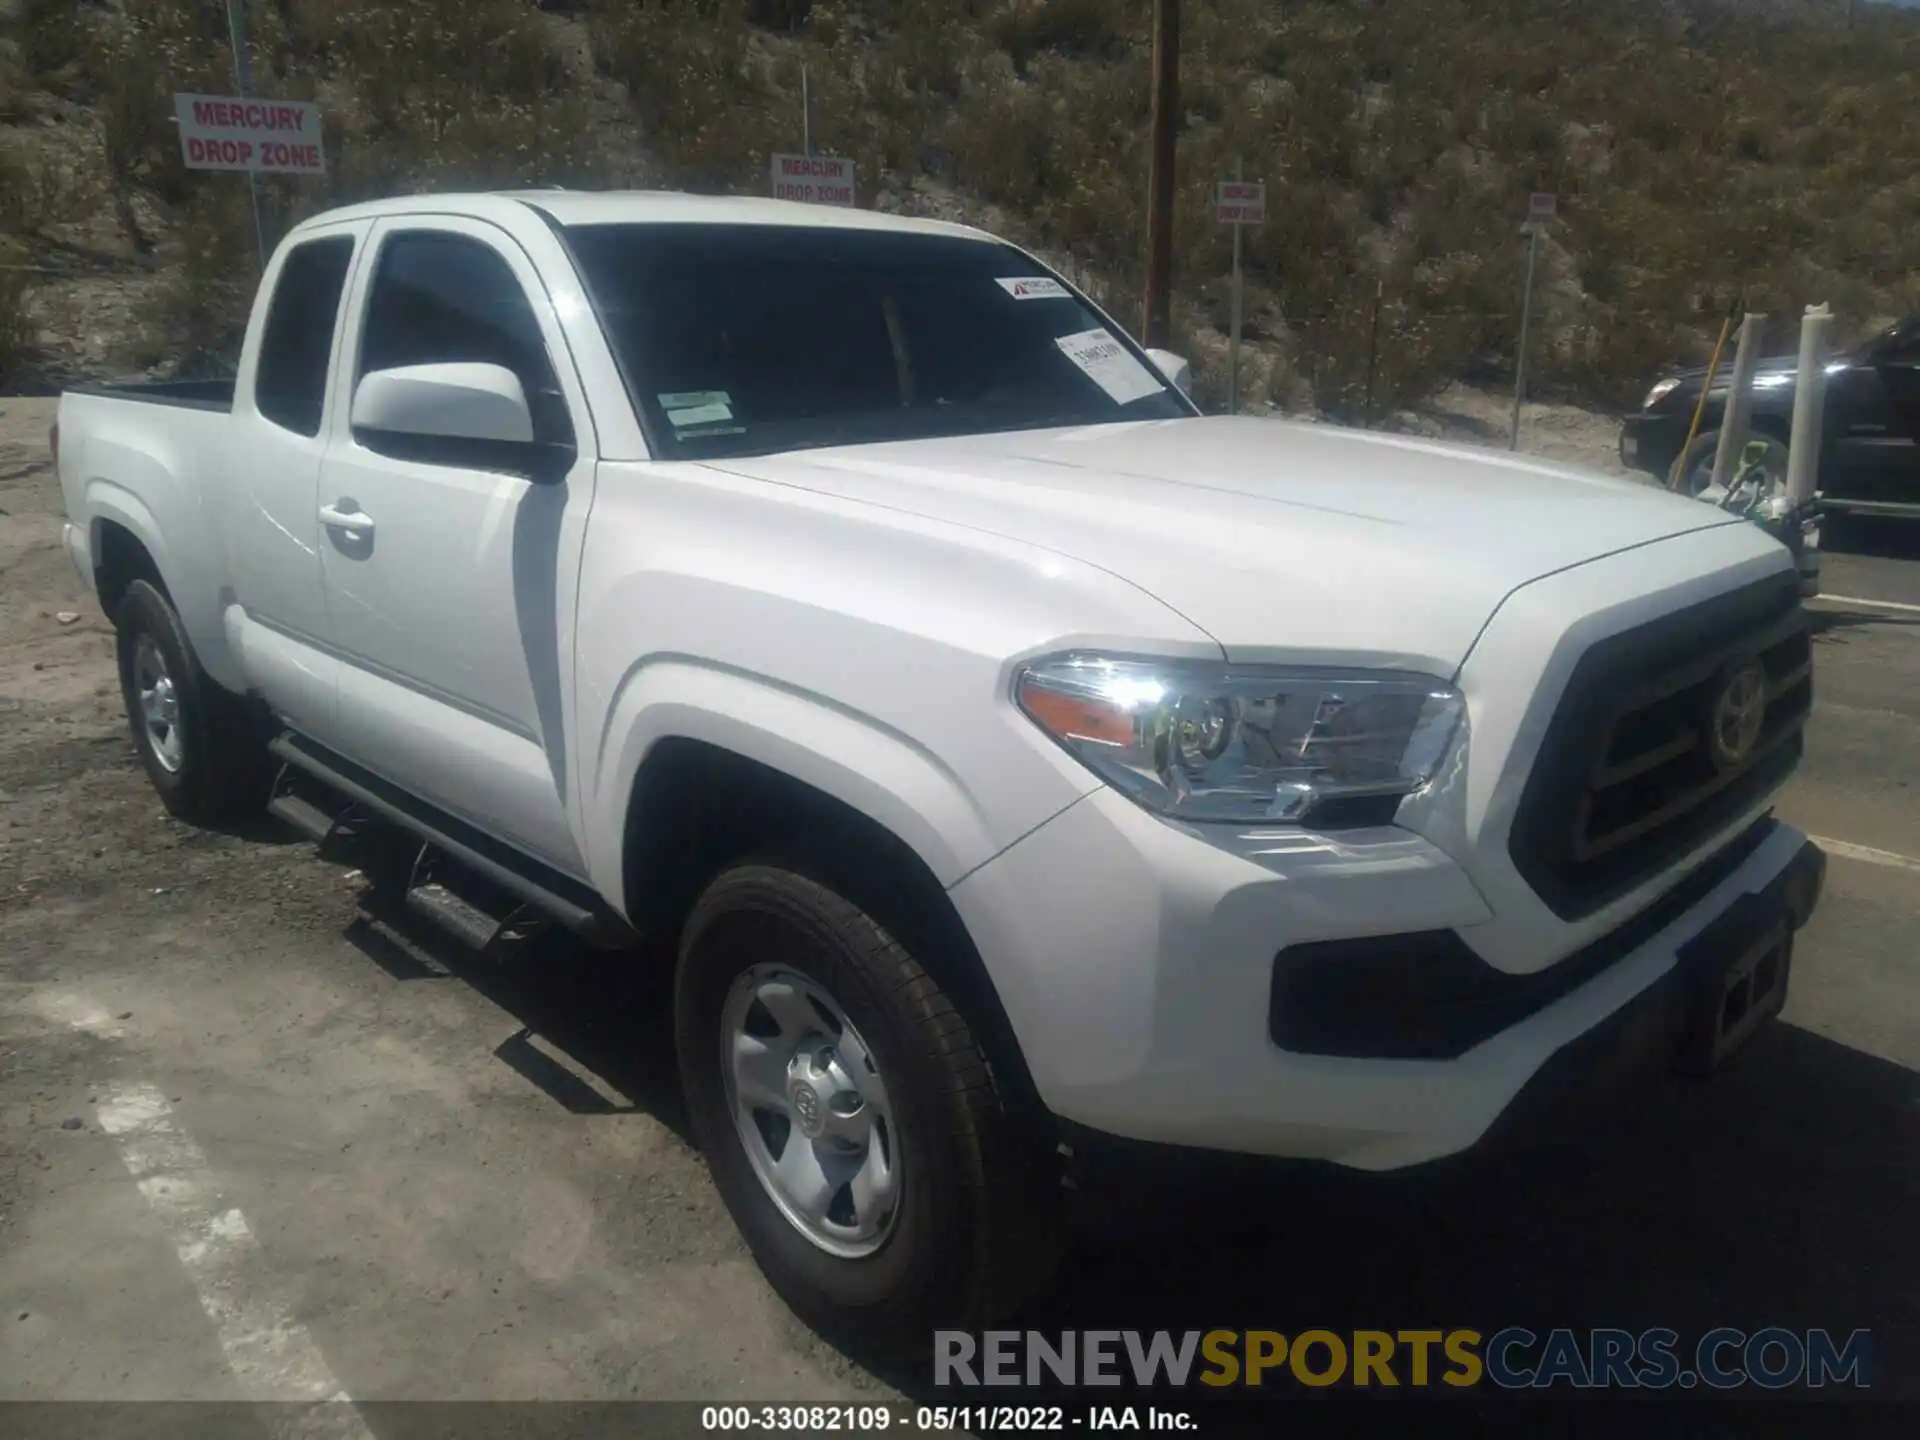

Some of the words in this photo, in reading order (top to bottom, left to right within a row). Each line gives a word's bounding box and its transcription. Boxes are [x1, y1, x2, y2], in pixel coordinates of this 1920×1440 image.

[193, 101, 304, 131] MERCURY
[187, 137, 253, 165] DROP
[260, 142, 321, 168] ZONE
[781, 158, 844, 178] MERCURY
[776, 183, 813, 203] DROP
[817, 186, 852, 203] ZONE
